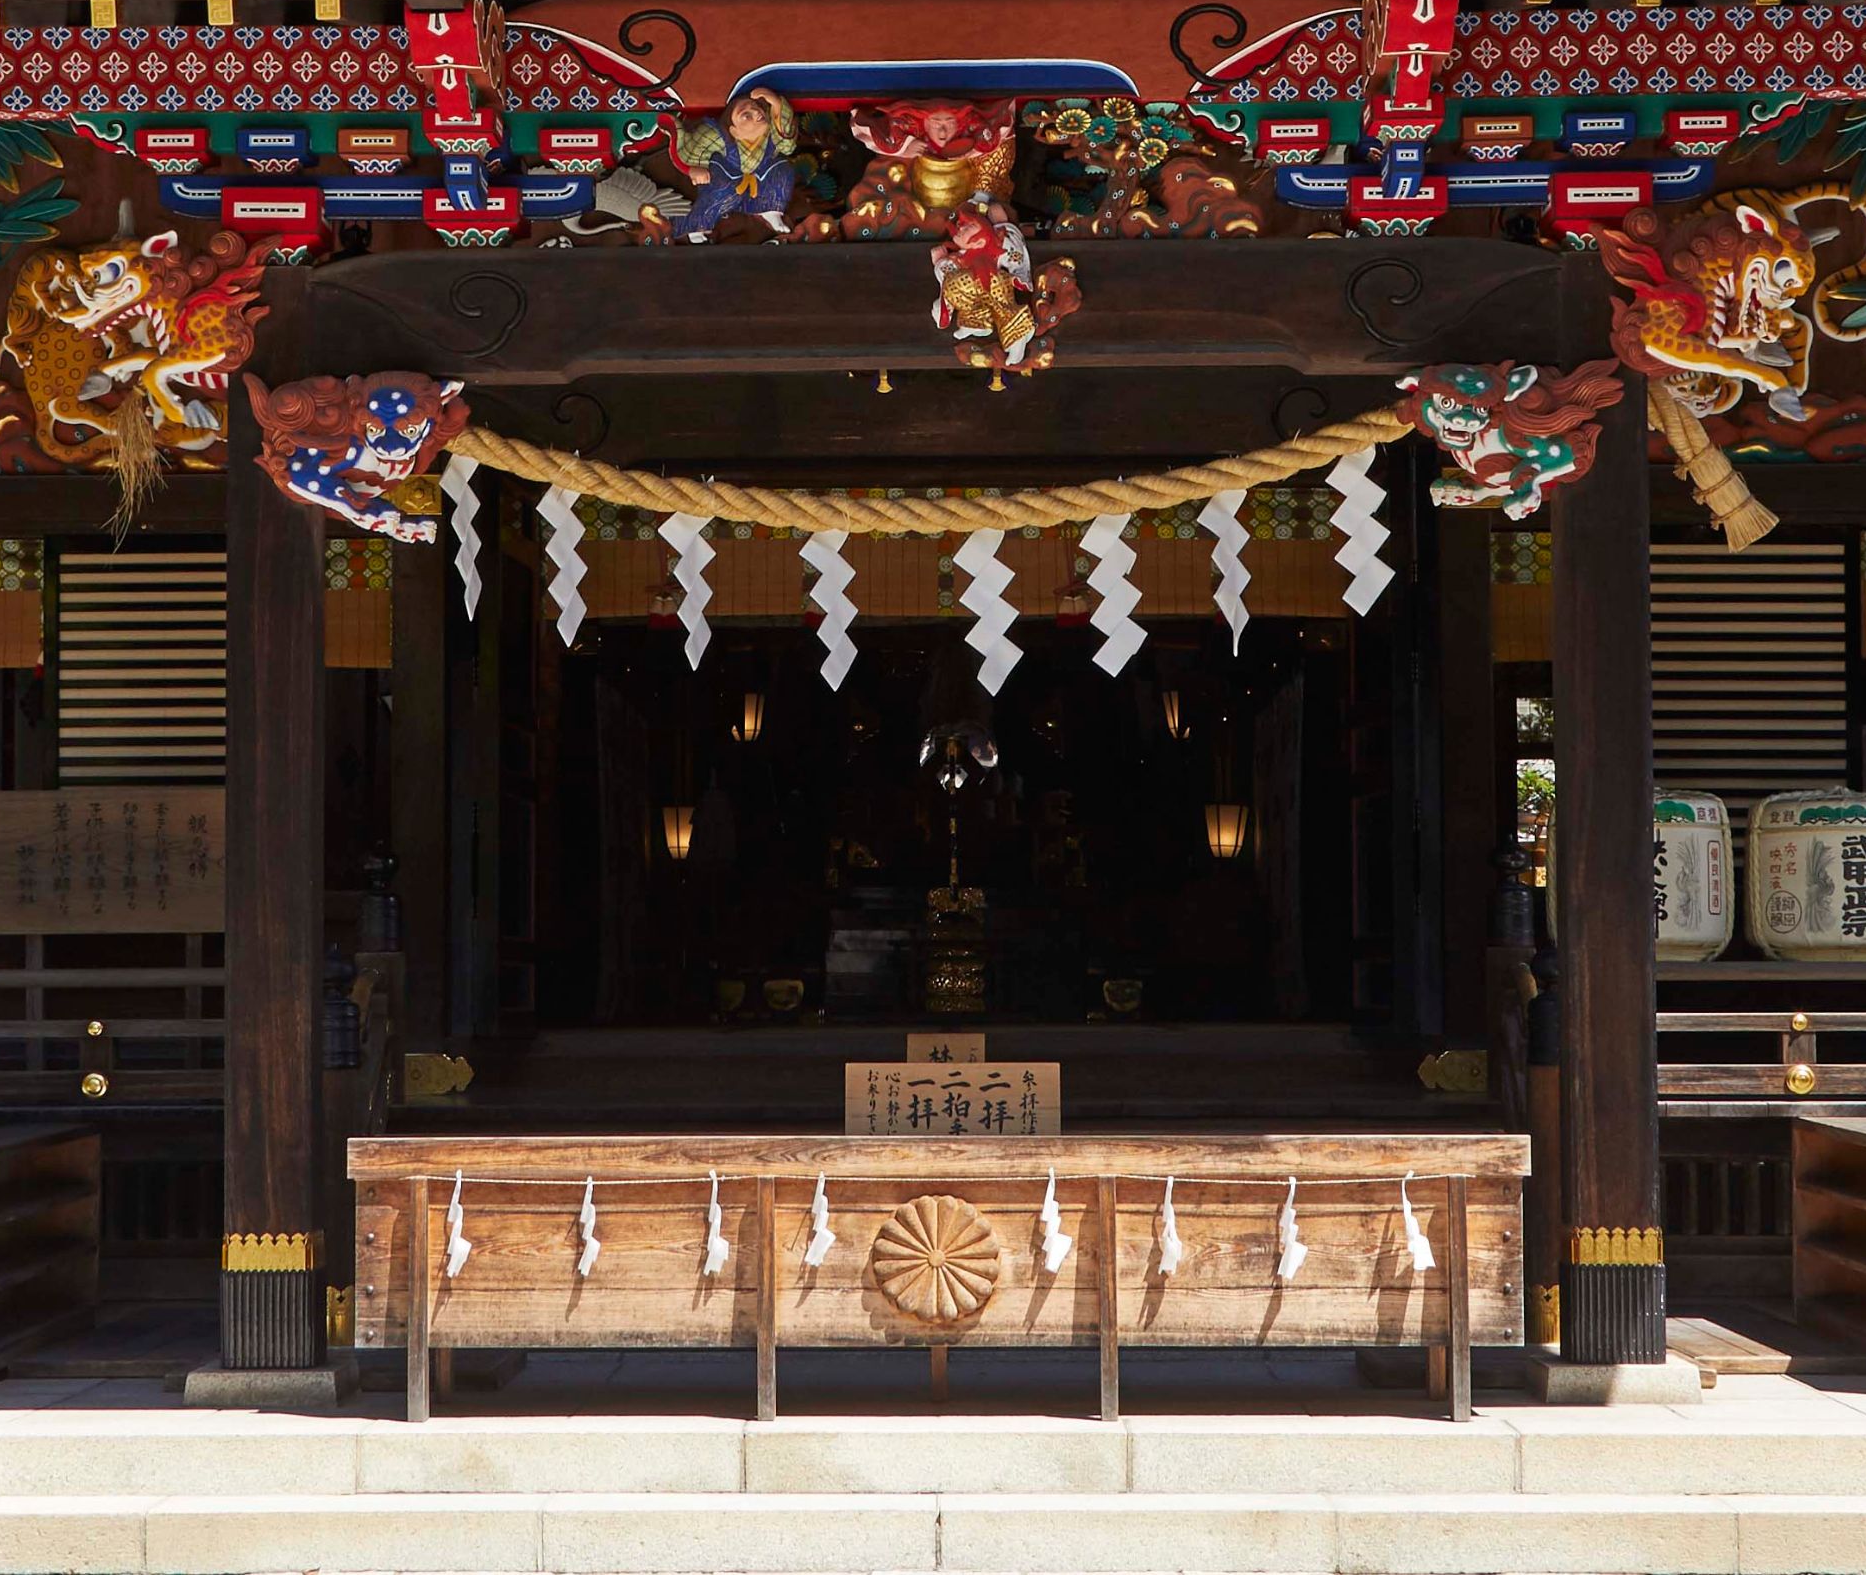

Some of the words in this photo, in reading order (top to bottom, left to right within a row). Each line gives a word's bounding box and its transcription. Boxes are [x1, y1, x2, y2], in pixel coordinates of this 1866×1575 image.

[906, 1078, 938, 1129] 一拝
[941, 1071, 971, 1135] 二拍手
[979, 1072, 1015, 1134] 二拝
